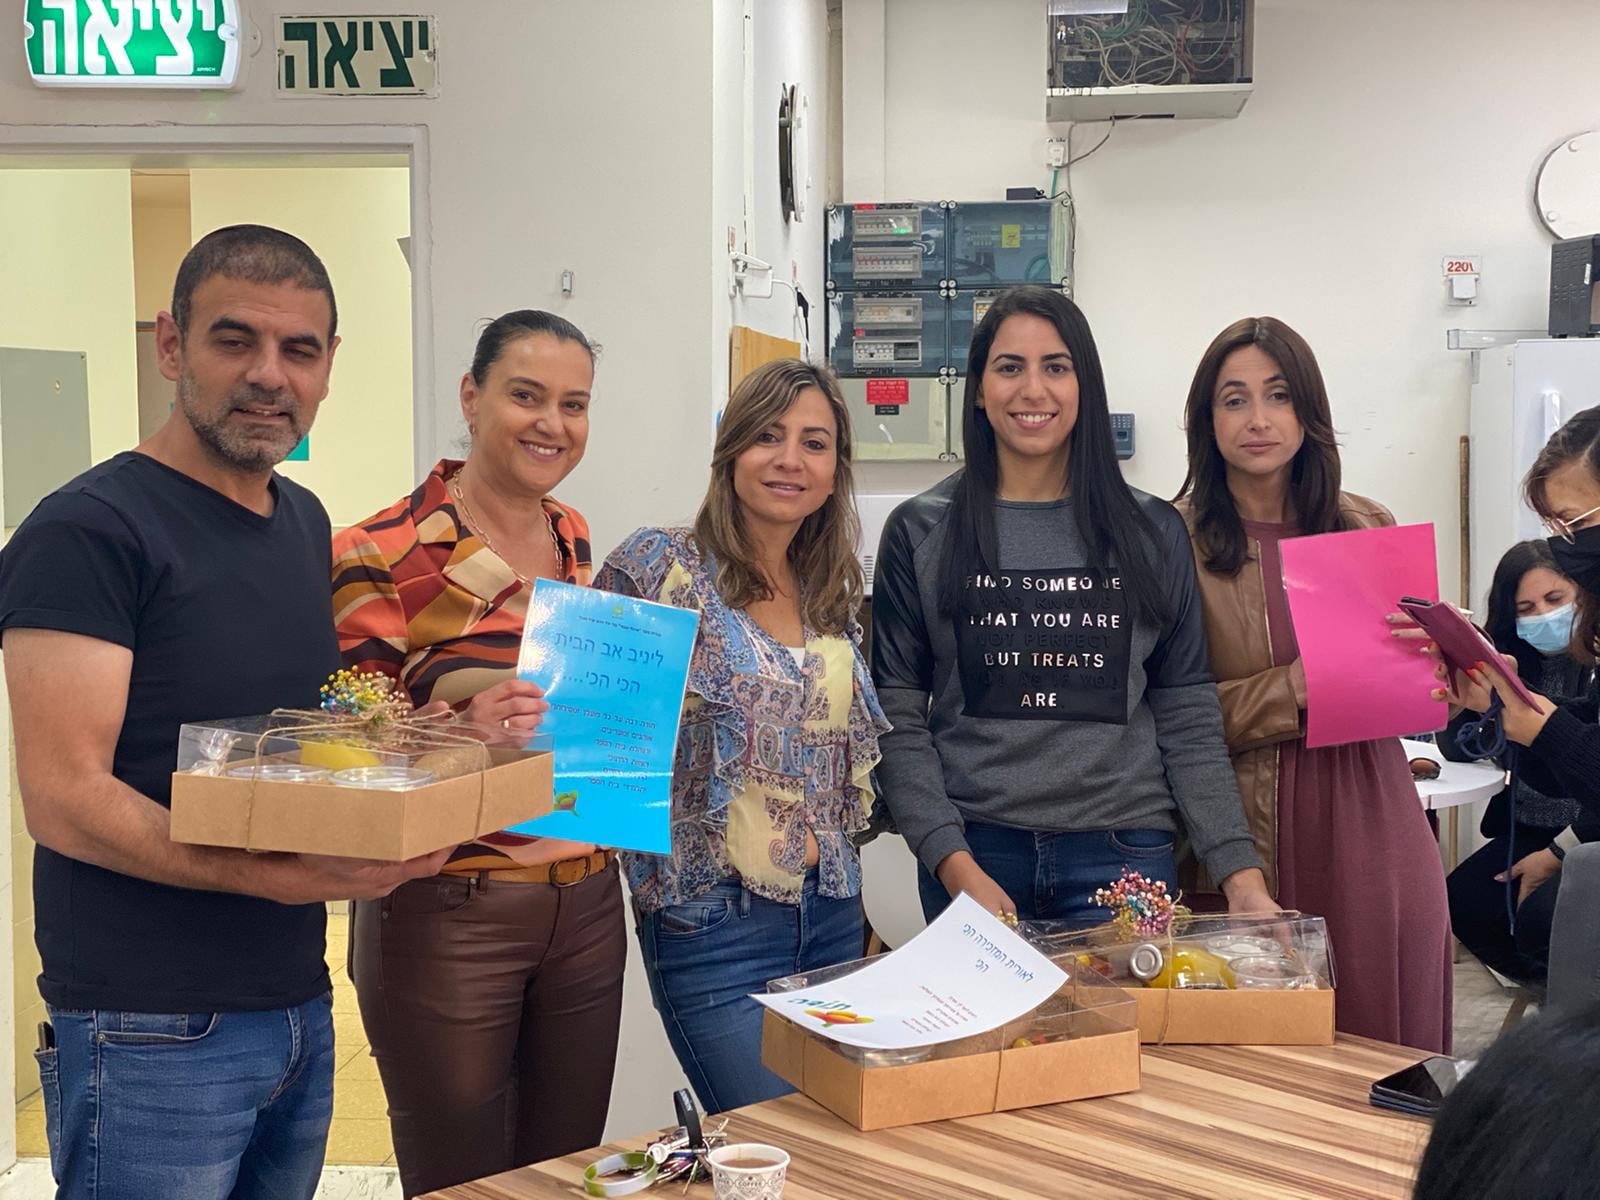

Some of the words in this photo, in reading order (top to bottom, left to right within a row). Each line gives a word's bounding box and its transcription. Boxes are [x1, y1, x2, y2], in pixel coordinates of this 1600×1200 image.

[42, 0, 216, 75] יציאה
[283, 21, 429, 88] יציאה
[1030, 613, 1072, 628] YOU
[1081, 613, 1121, 629] ARE
[554, 632, 595, 653] הבית
[1024, 633, 1113, 649] PERFECT
[601, 642, 623, 659] אב
[627, 648, 664, 668] ליניב
[984, 651, 1021, 667] BUT
[1031, 652, 1105, 669] TREATS
[617, 677, 641, 695] הכי
[1021, 692, 1058, 708] ARE
